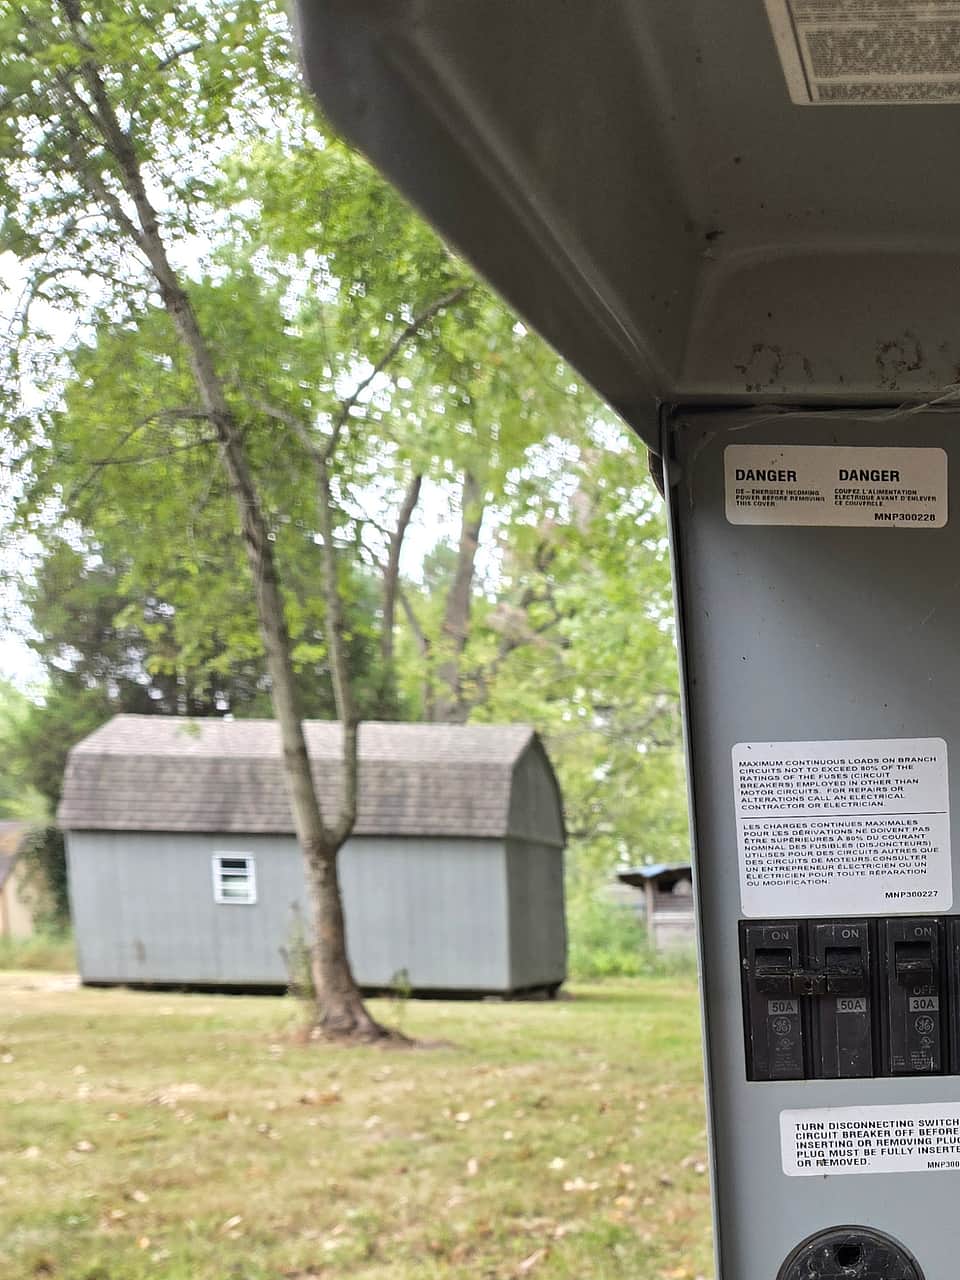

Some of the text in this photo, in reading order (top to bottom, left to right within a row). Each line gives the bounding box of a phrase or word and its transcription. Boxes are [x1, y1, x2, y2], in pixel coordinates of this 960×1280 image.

[735, 469, 797, 482] DANGER
[839, 470, 899, 482] DANGER
[738, 759, 783, 767] MAXIMUM
[785, 758, 845, 766] CONTINUOUS
[739, 774, 779, 782] RATINGS
[740, 781, 793, 789] BREAKERS)
[741, 795, 804, 803] ALTERATIONS
[792, 828, 852, 836] DÉRIVATIONS
[770, 835, 834, 844] SUPÉRIEURES
[809, 842, 853, 850] FUSIBLES
[856, 840, 932, 849] (DISJONCTEURS)
[766, 857, 808, 865] CIRCUITS
[761, 864, 834, 872] ENTREPRENEUR
[837, 862, 895, 870] ÉLECTRICIEN
[746, 872, 805, 880] ÉLECTRICIEN
[885, 890, 938, 899] MNP300227
[771, 931, 789, 940] ON
[842, 930, 859, 939] ON
[914, 928, 932, 936] ON
[913, 985, 935, 995] OFF
[772, 1003, 794, 1012] 50A
[841, 1000, 862, 1010] 50A
[913, 999, 935, 1009] 30A
[795, 1122, 824, 1131] TURN
[828, 1120, 913, 1130] DISCONNECTING
[918, 1118, 959, 1127] SWITCH
[795, 1127, 958, 1140] CIRCUIT BREAKER OFF BEFORE
[796, 1140, 853, 1149] INSERTING
[857, 1139, 871, 1147] OR
[876, 1138, 931, 1147] REMOVING
[796, 1150, 824, 1158] PLUG
[828, 1149, 858, 1157] MUST
[863, 1148, 876, 1156] BE
[880, 1147, 913, 1156] FULLY
[797, 1158, 870, 1168] OR REMOVED.
